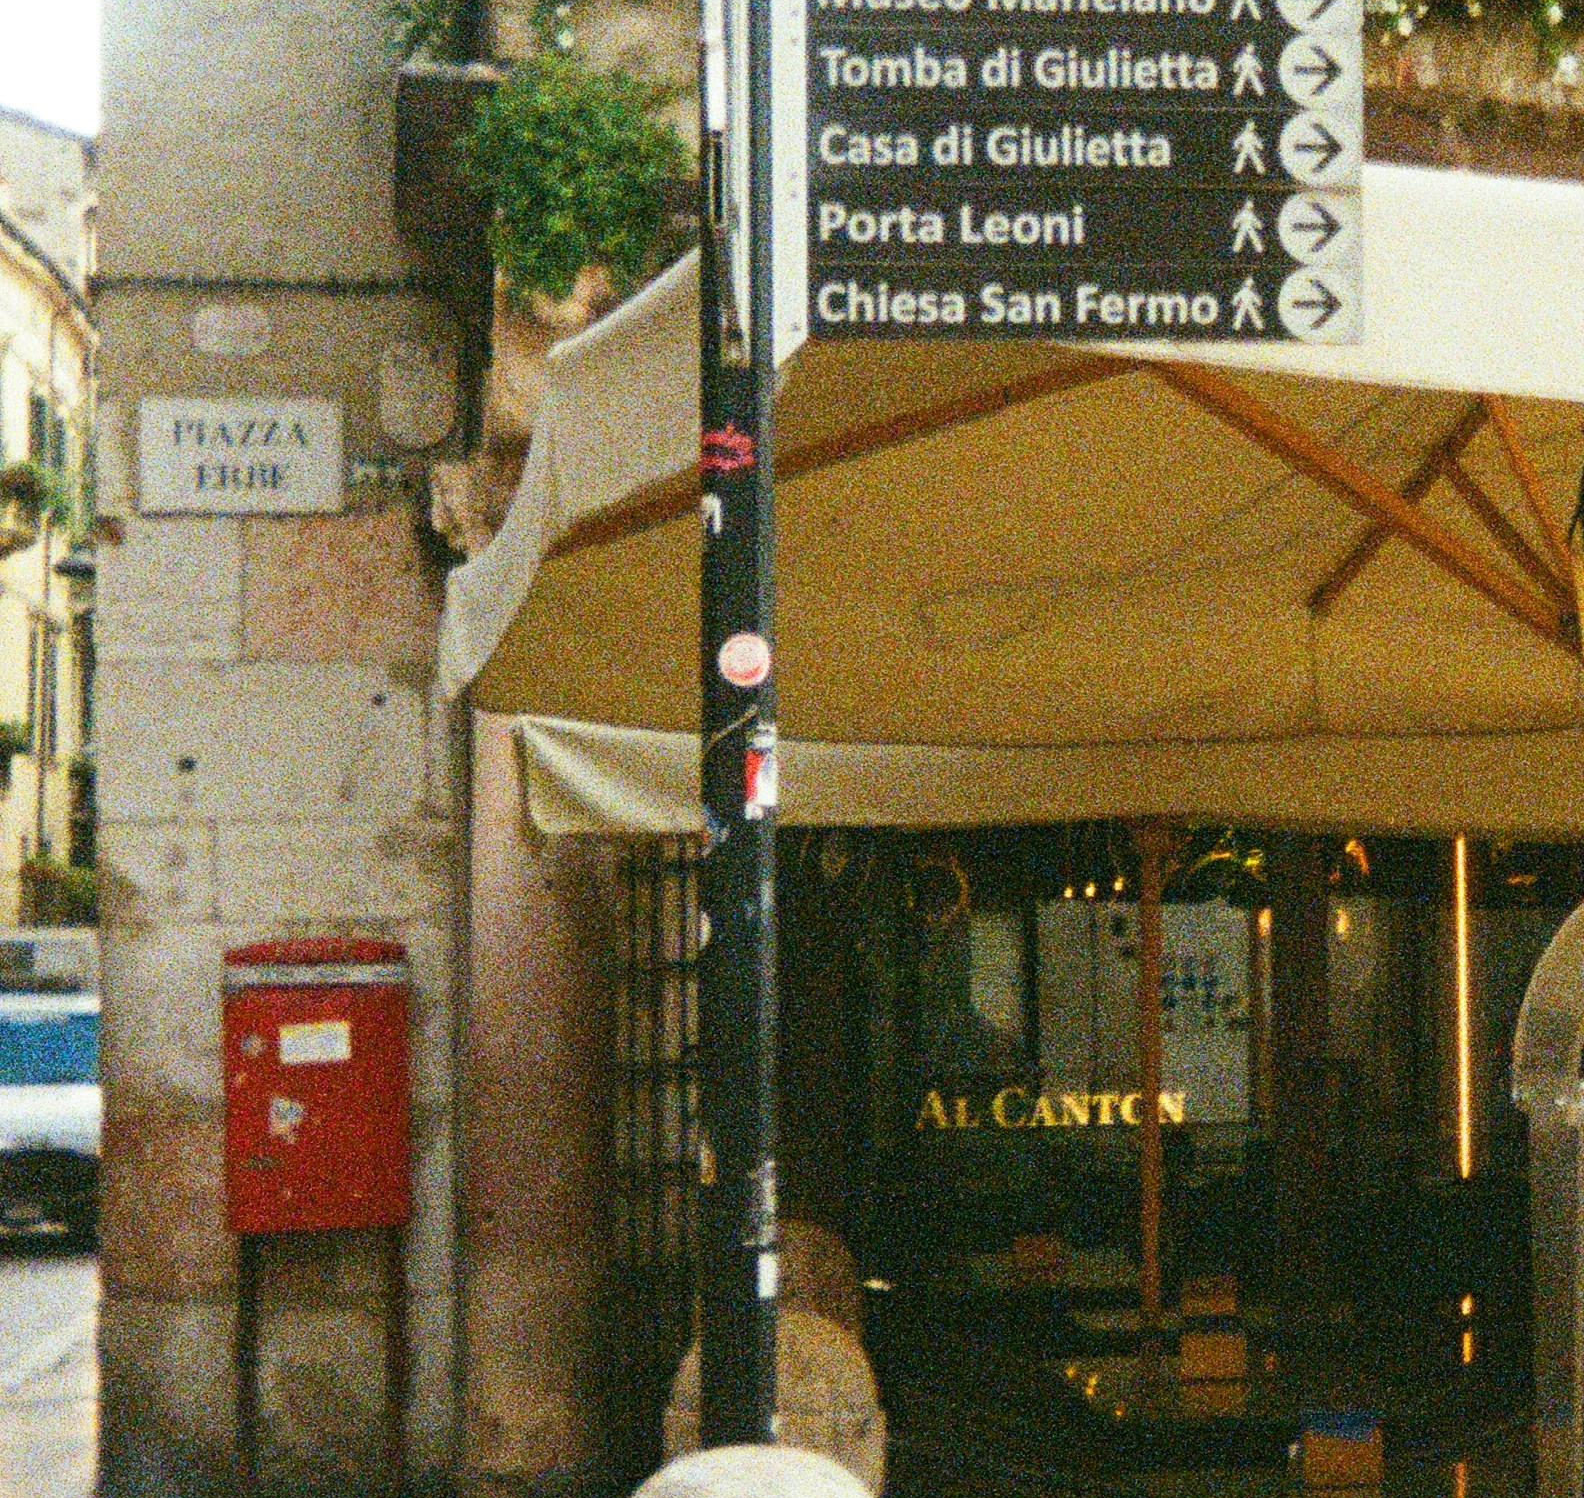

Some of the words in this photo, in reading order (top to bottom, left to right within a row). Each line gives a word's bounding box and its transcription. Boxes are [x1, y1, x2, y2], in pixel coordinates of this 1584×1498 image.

[818, 48, 967, 88] Tomba
[982, 47, 1021, 89] di
[1034, 49, 1219, 91] Giulietta
[818, 126, 919, 165] Casa
[932, 125, 974, 166] di
[987, 126, 1172, 168] Giulietta
[818, 203, 944, 244] Porta
[960, 205, 1085, 245] Leoni
[817, 280, 966, 324] Chiesa
[981, 283, 1061, 324] San
[1077, 286, 1219, 326] Fermo
[172, 419, 309, 448] PIAZZA
